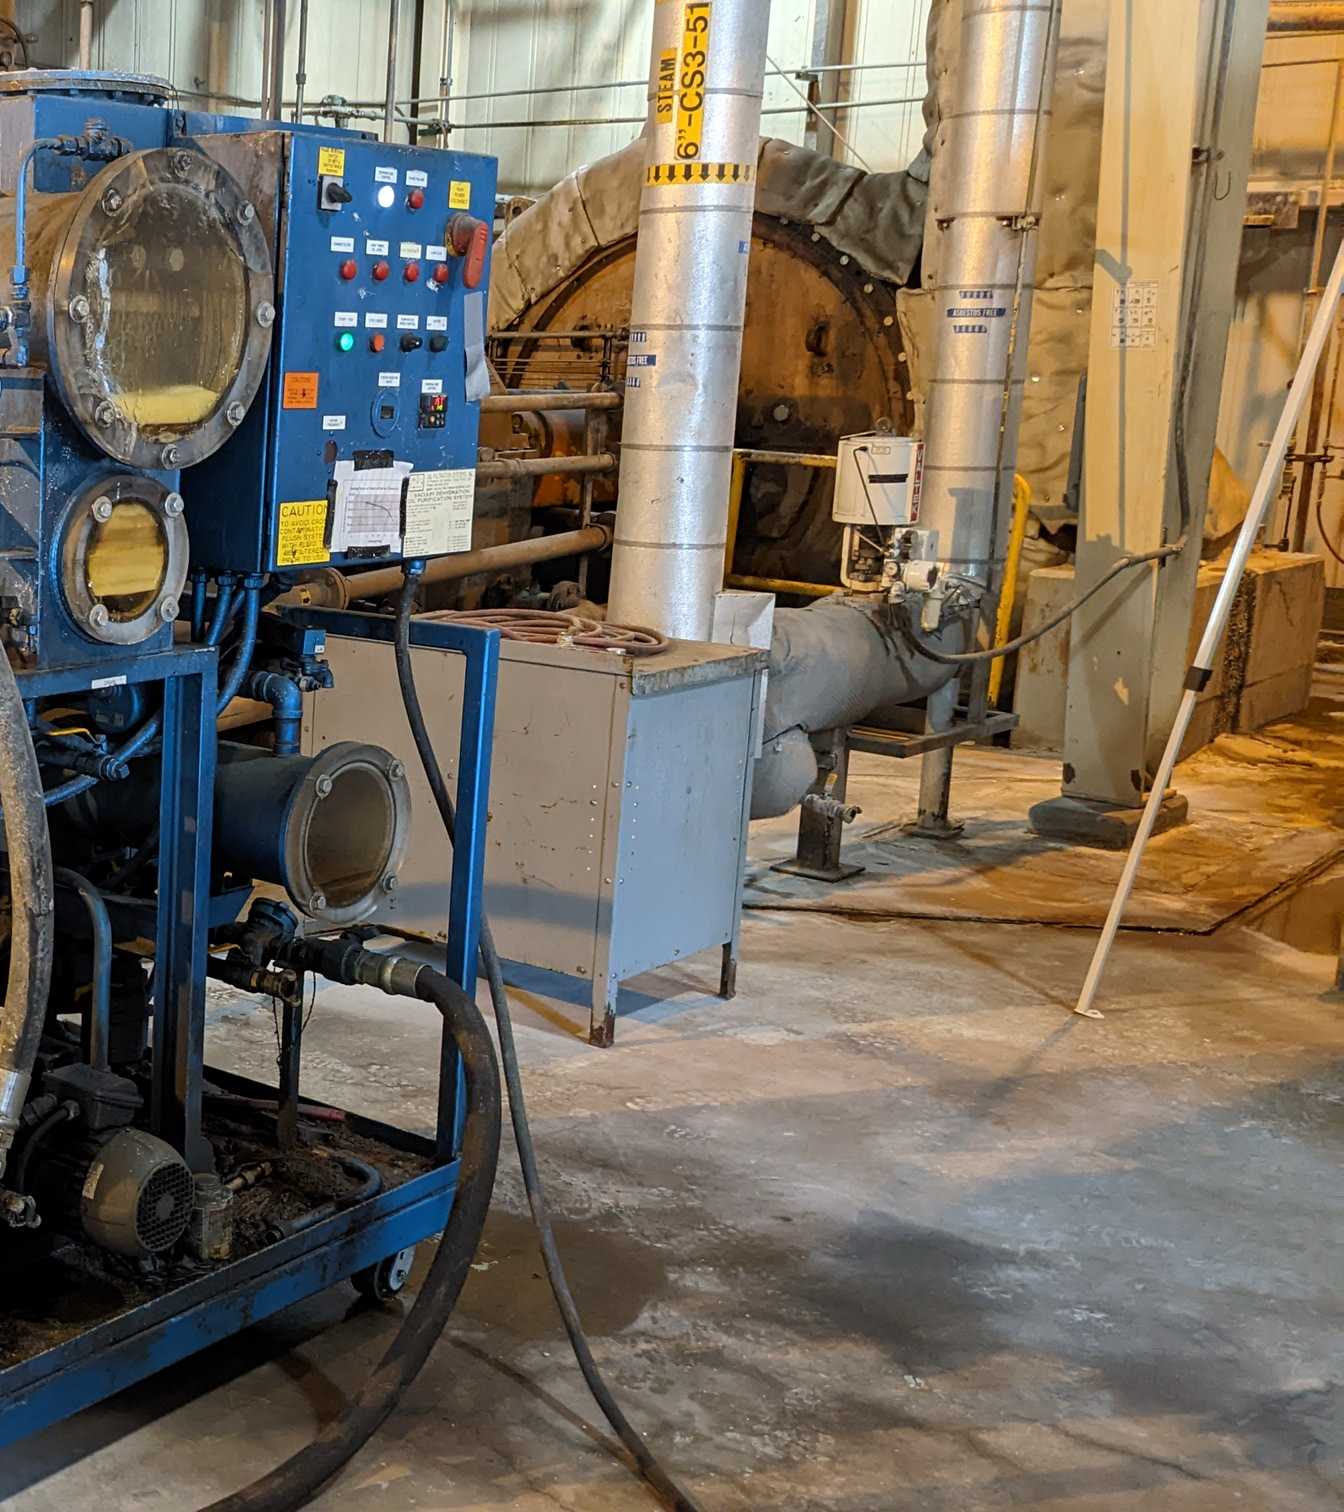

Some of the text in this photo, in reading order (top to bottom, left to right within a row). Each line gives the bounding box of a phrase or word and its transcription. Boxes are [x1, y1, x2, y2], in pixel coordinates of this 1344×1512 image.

[657, 58, 675, 113] STEAM
[982, 307, 997, 317] FREE
[637, 356, 648, 364] FREE
